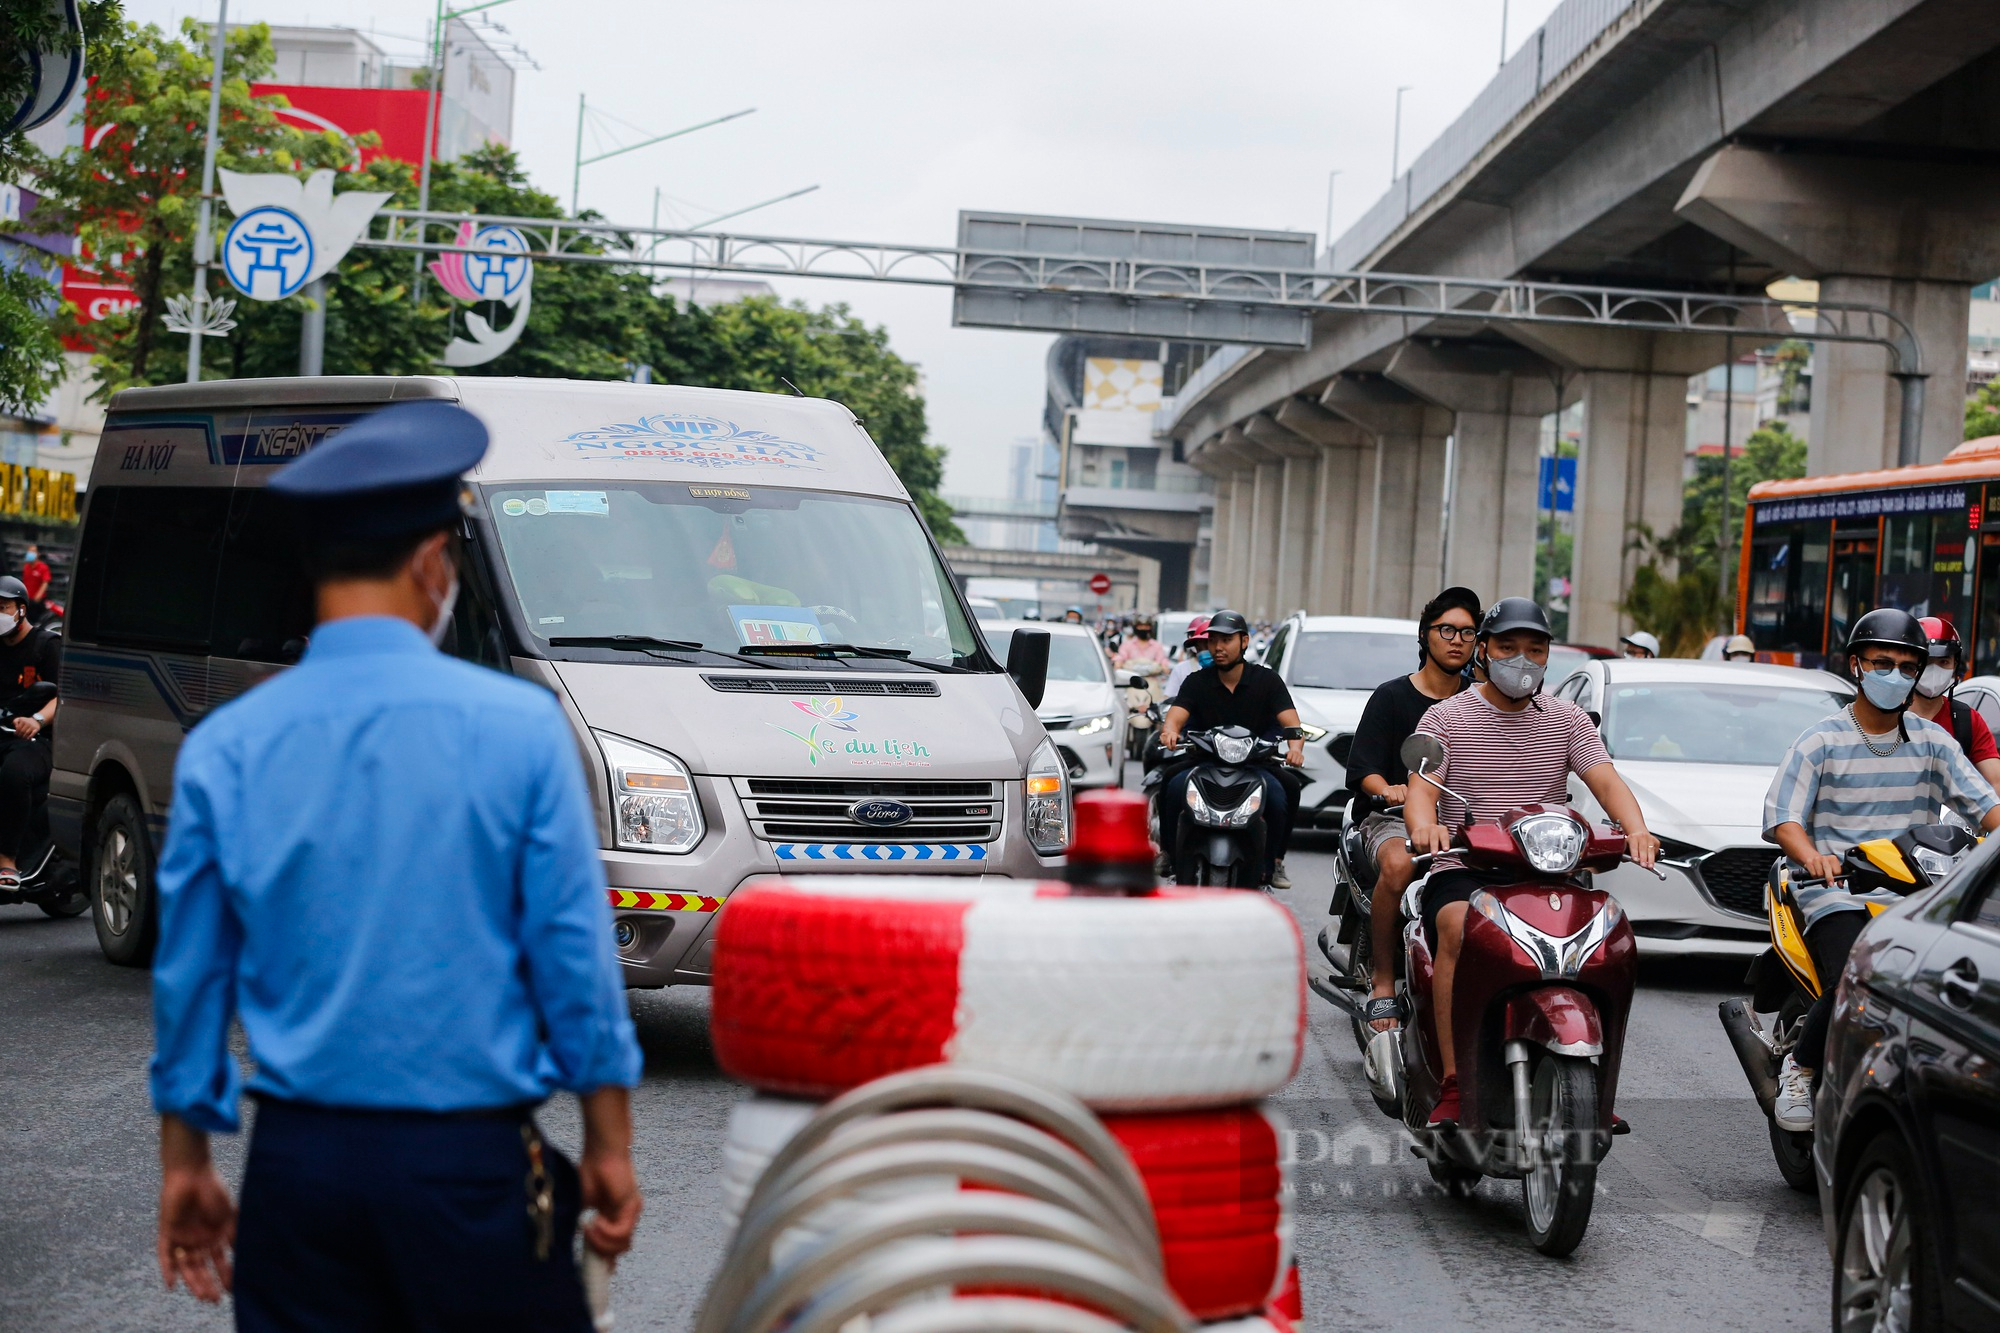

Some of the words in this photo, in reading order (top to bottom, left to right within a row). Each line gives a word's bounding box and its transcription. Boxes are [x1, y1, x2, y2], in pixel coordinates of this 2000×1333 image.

[662, 420, 720, 435] VIP
[624, 450, 786, 464] 0836.649.649
[691, 488, 703, 496] XE
[845, 738, 878, 754] du
[884, 739, 931, 759] lịch
[866, 803, 900, 818] Ford
